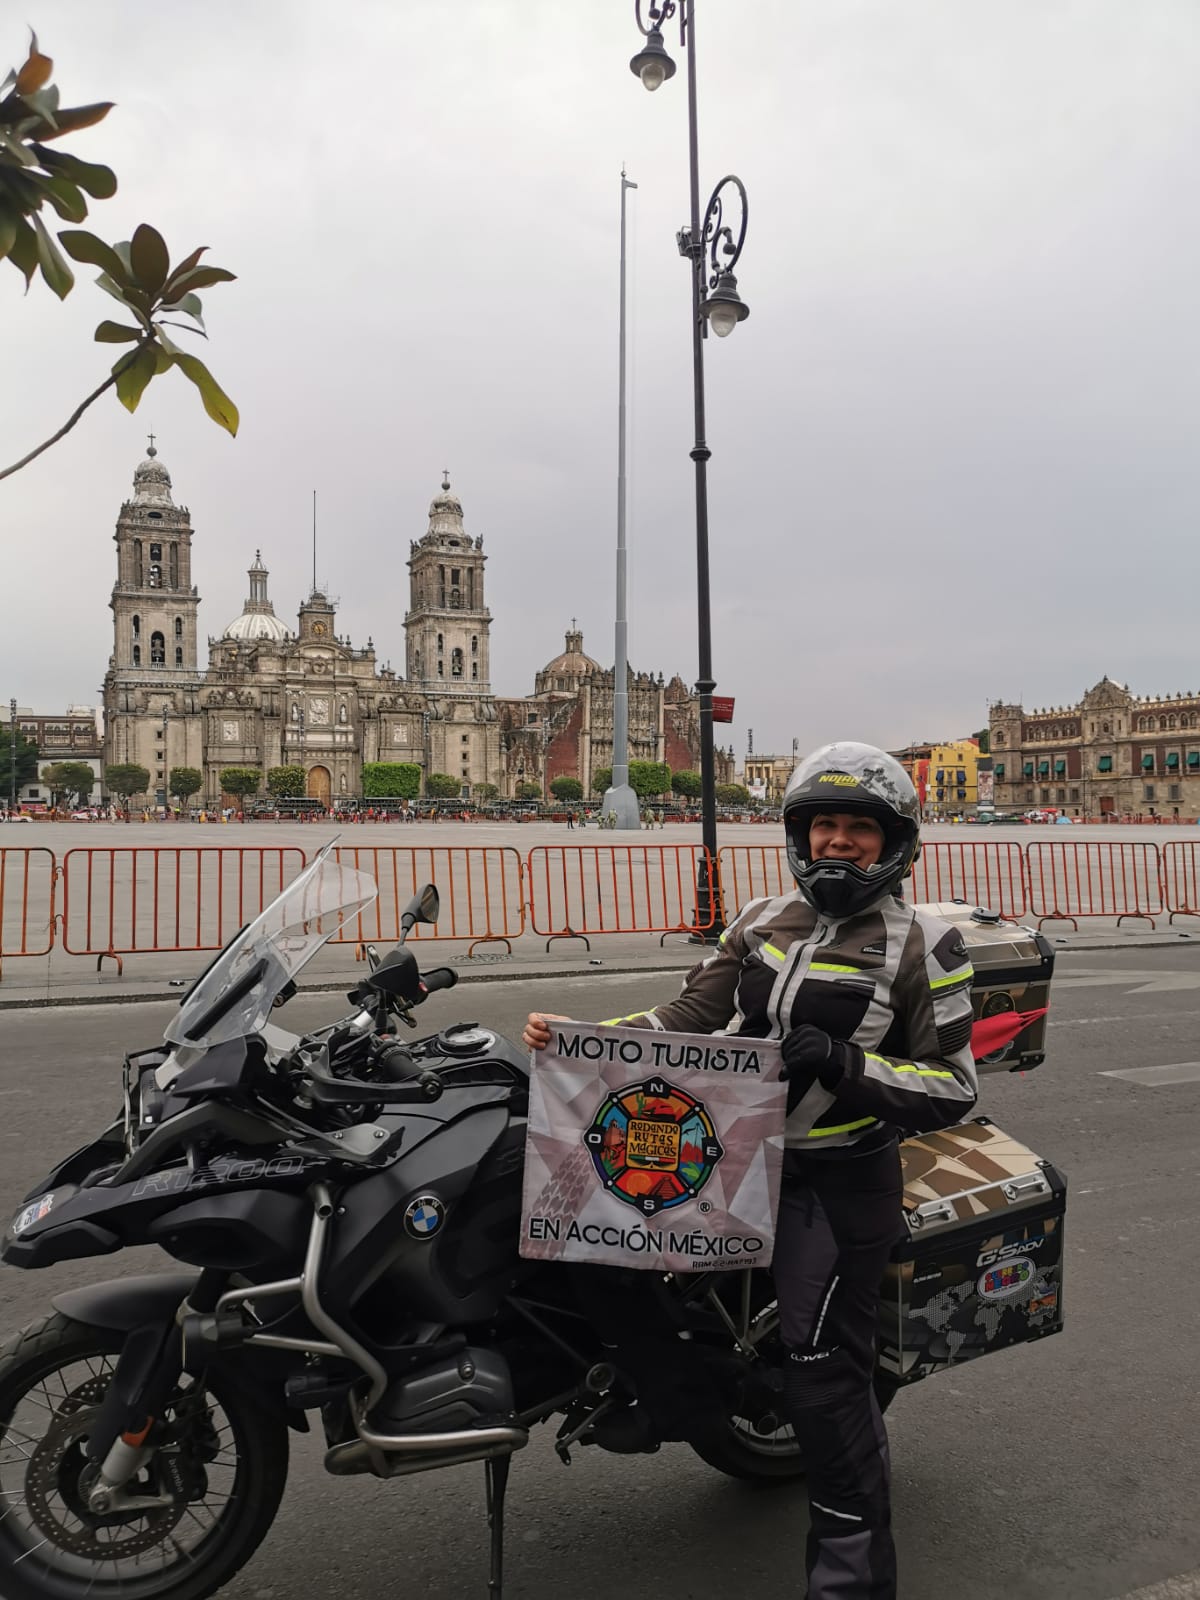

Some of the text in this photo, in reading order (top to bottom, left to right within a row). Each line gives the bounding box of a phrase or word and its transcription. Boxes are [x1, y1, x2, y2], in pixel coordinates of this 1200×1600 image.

[818, 774, 863, 786] NOLAN
[557, 1032, 761, 1074] MOTO TURISTA
[650, 1083, 664, 1093] N
[706, 1146, 718, 1157] E
[643, 1200, 655, 1210] S
[529, 1217, 764, 1257] EN ACCIÓN MÉXICO
[168, 1458, 185, 1493] brembo
